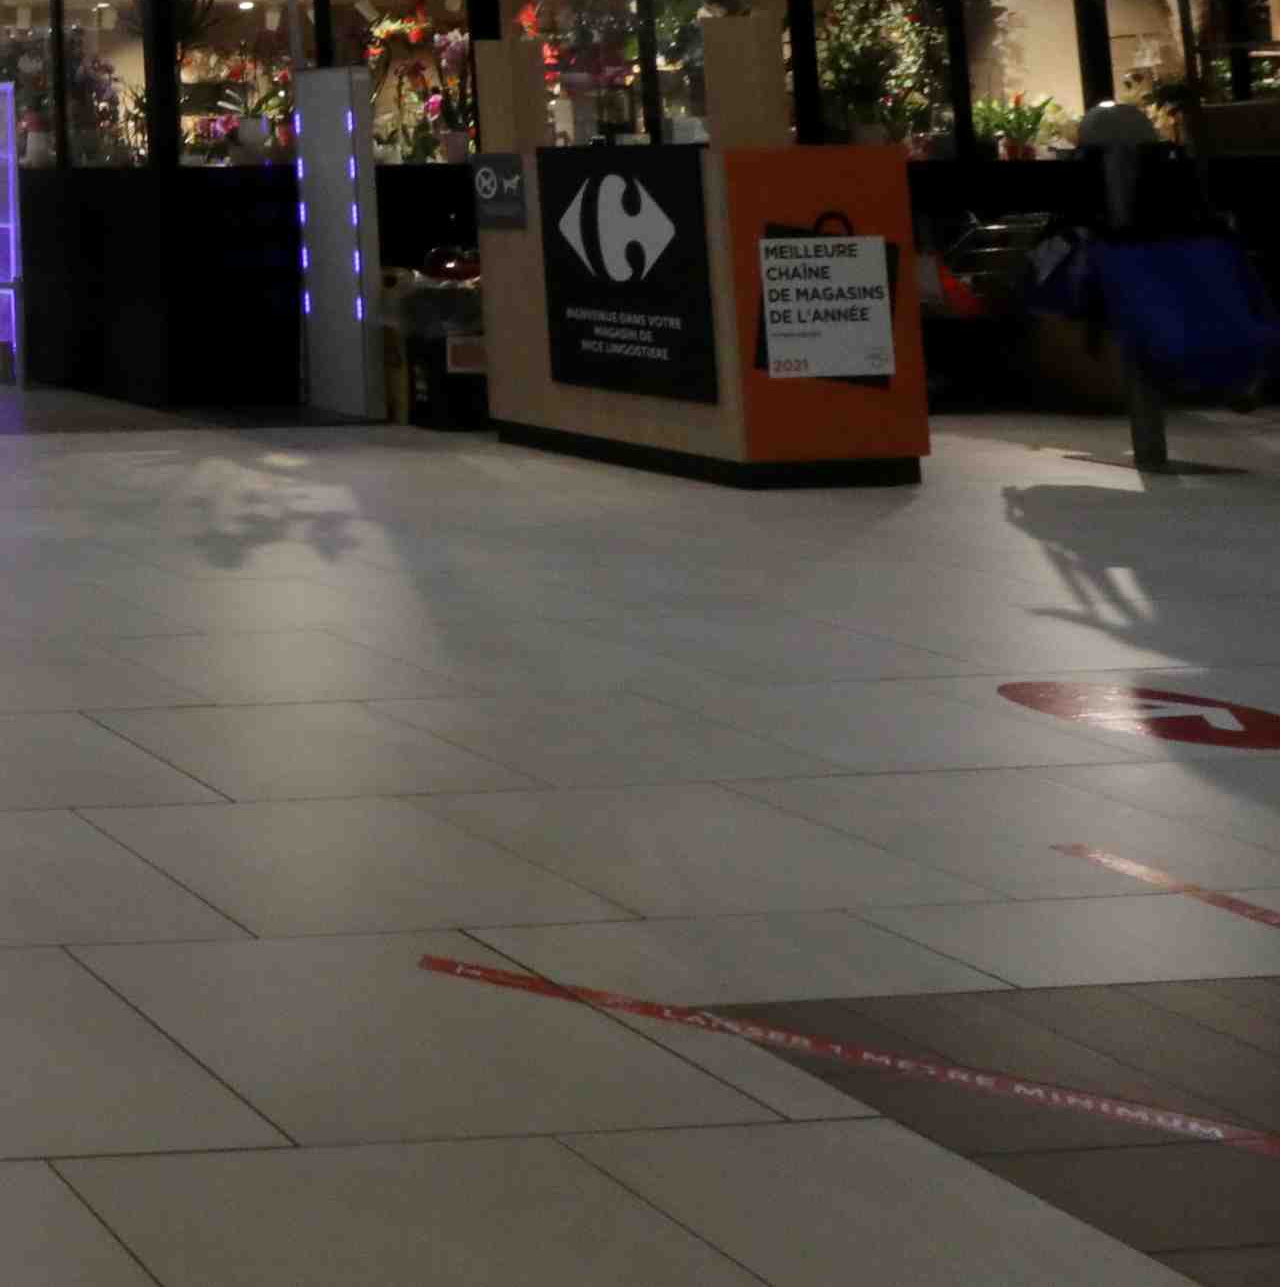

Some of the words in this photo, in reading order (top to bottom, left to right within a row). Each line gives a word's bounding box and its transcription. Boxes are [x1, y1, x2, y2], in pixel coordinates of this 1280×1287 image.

[764, 243, 858, 260] MEILLEURE
[766, 262, 831, 281] CHAÎNE
[768, 288, 792, 303] DE
[795, 285, 885, 302] MAGASINS
[648, 314, 682, 331] VOTRE
[769, 309, 793, 325] DE
[797, 305, 870, 323] L'ANNÉE
[773, 359, 809, 372] 2021
